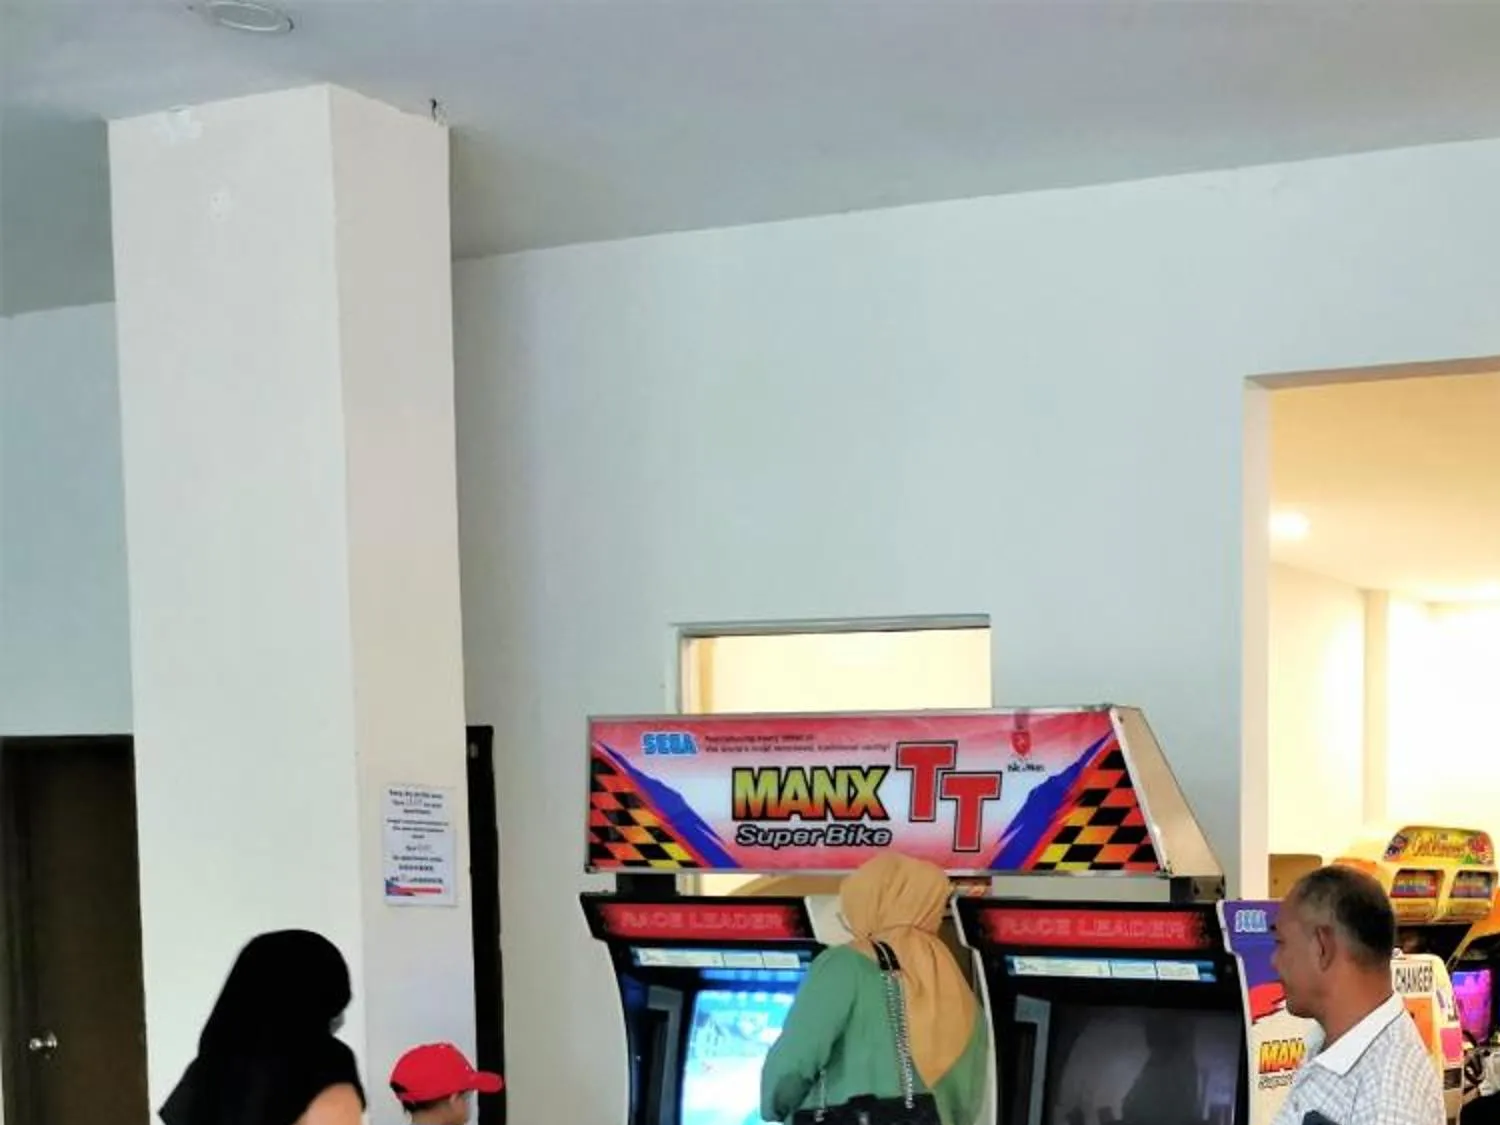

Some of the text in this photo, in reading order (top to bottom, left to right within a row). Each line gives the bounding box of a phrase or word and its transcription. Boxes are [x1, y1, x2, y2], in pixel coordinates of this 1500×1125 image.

[641, 732, 698, 756] SEGA
[731, 740, 1002, 853] MANX TT
[620, 911, 784, 931] RACE LEADER
[1000, 917, 1187, 940] RACE LEADER
[1234, 909, 1268, 933] SEGA
[1395, 965, 1434, 994] CHANGER
[1258, 1037, 1305, 1075] MAN
